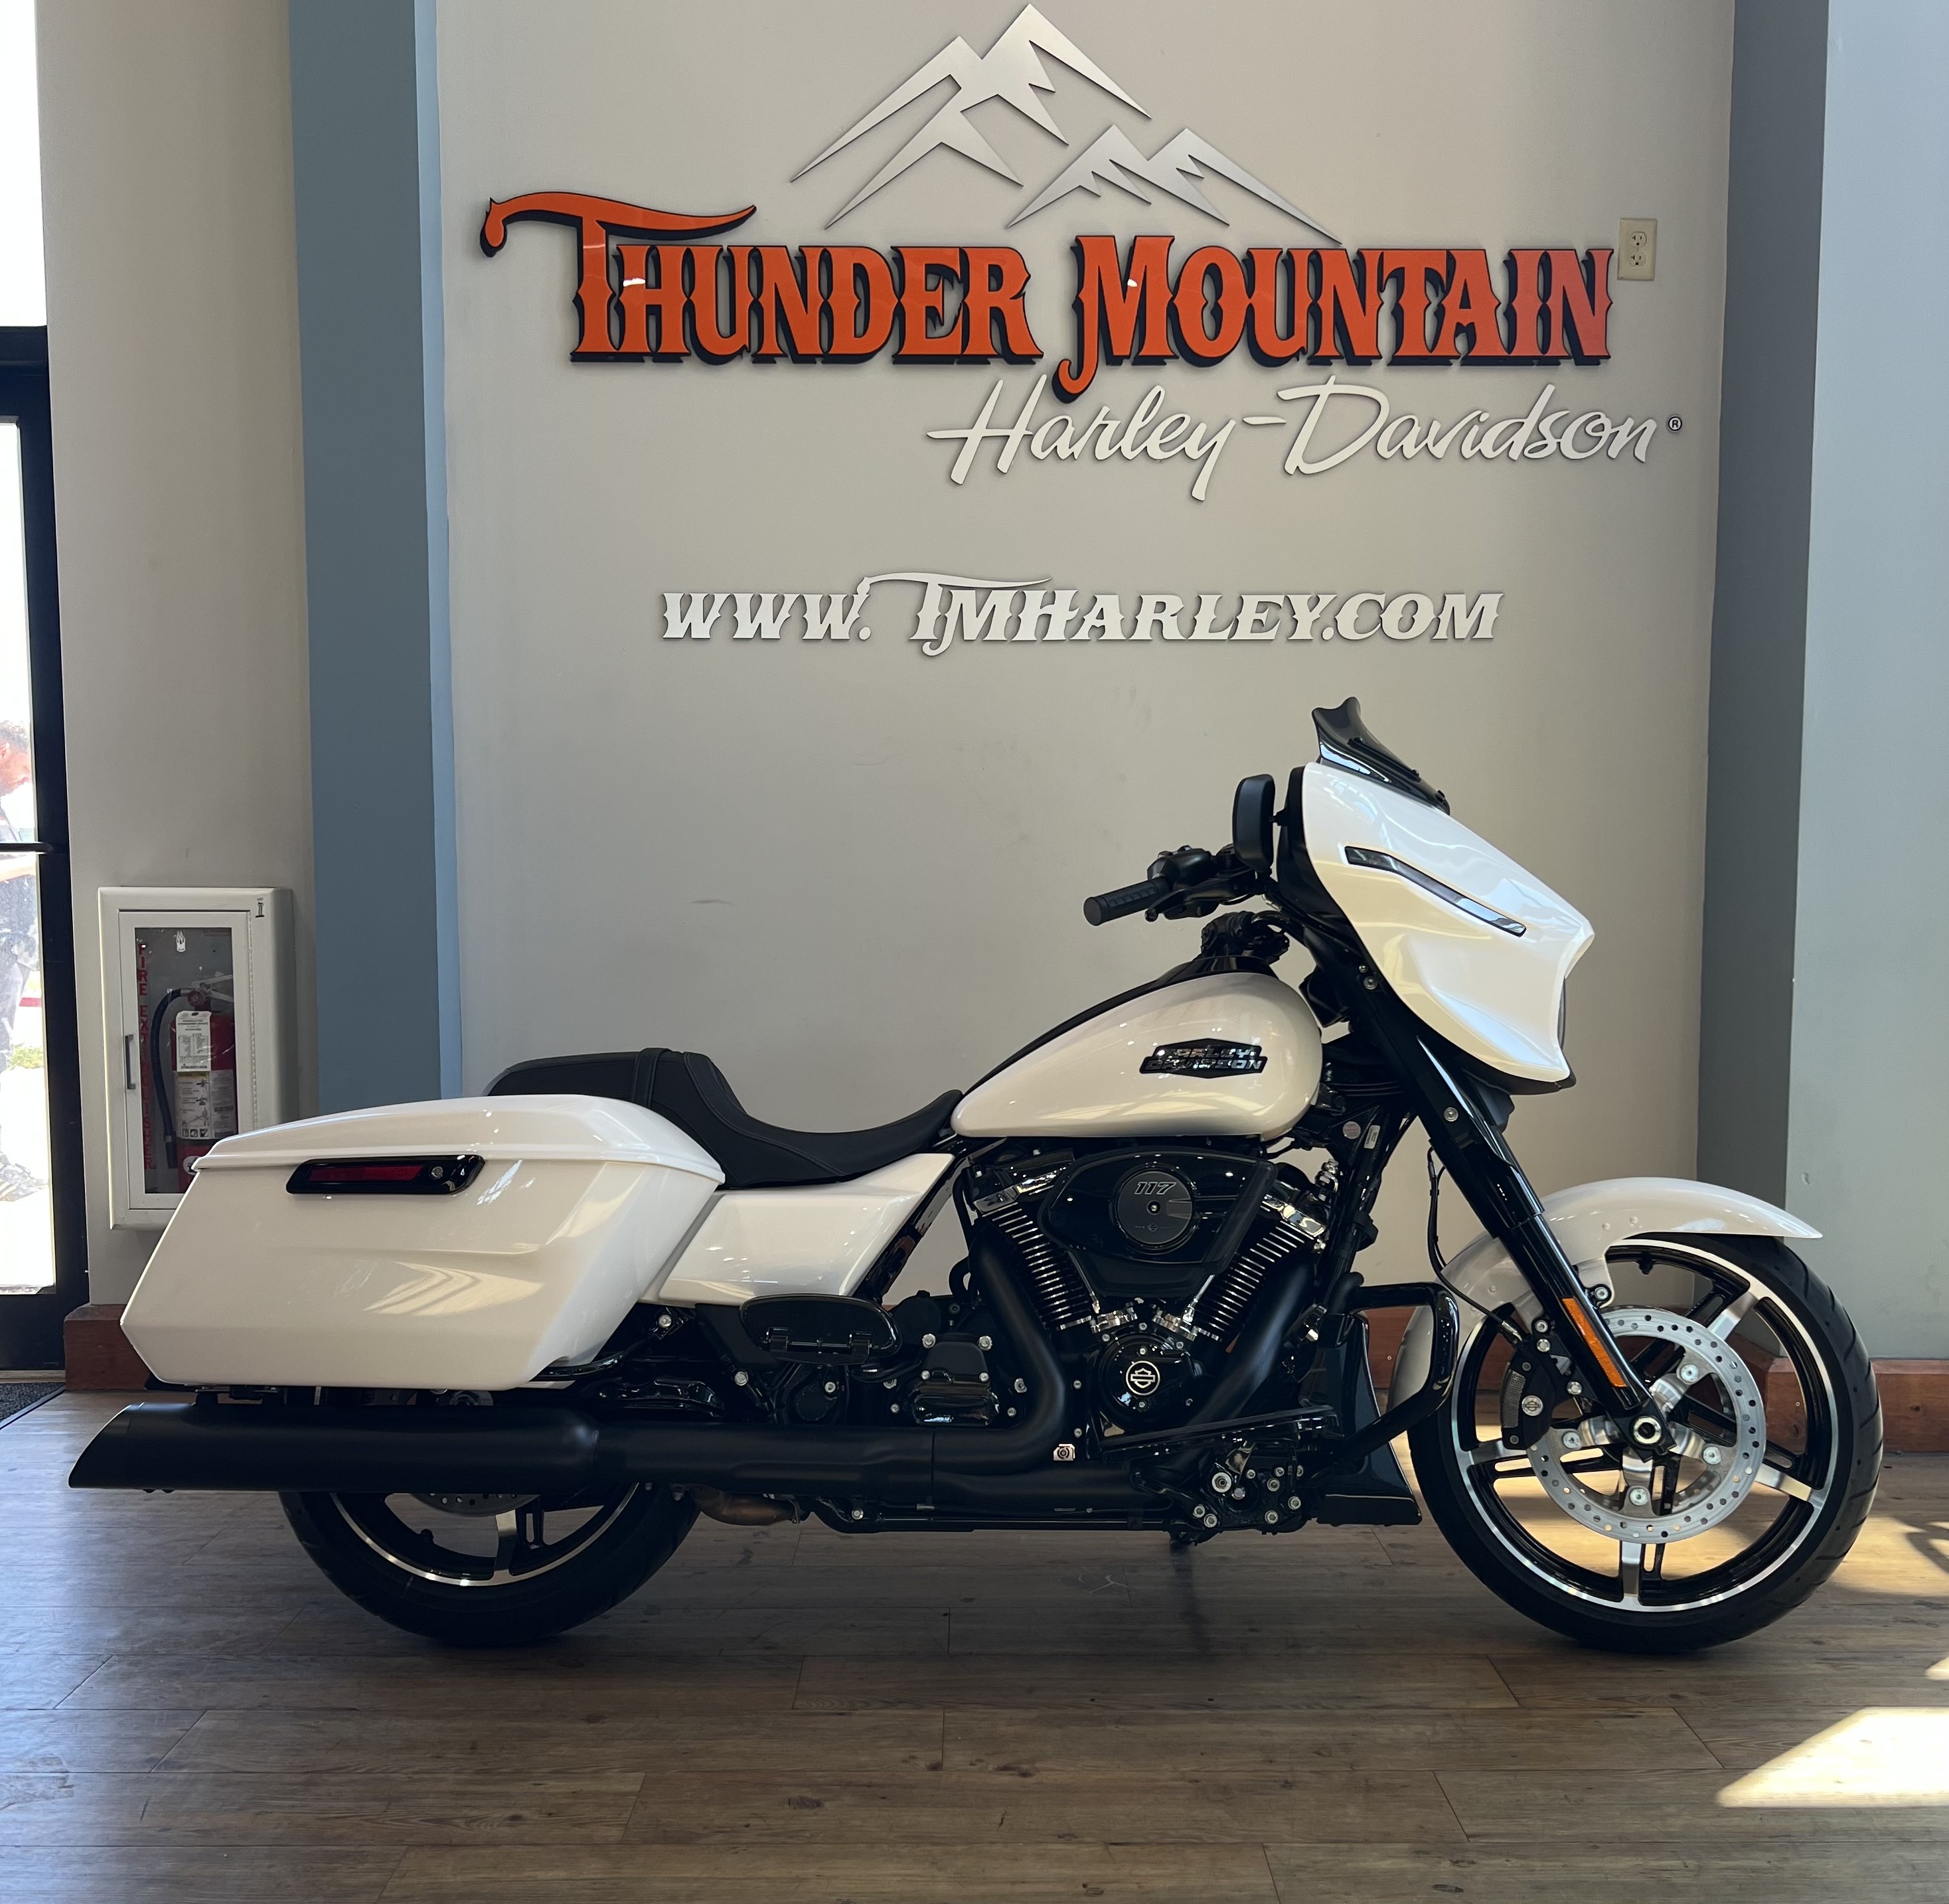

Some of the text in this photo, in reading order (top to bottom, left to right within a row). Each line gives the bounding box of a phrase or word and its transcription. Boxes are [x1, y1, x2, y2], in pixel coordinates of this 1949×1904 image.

[480, 191, 1614, 403] THUNDER MOUNTAIN
[138, 943, 155, 1170] FIRE EXTIUISHER
[1134, 1181, 1176, 1195] 117
